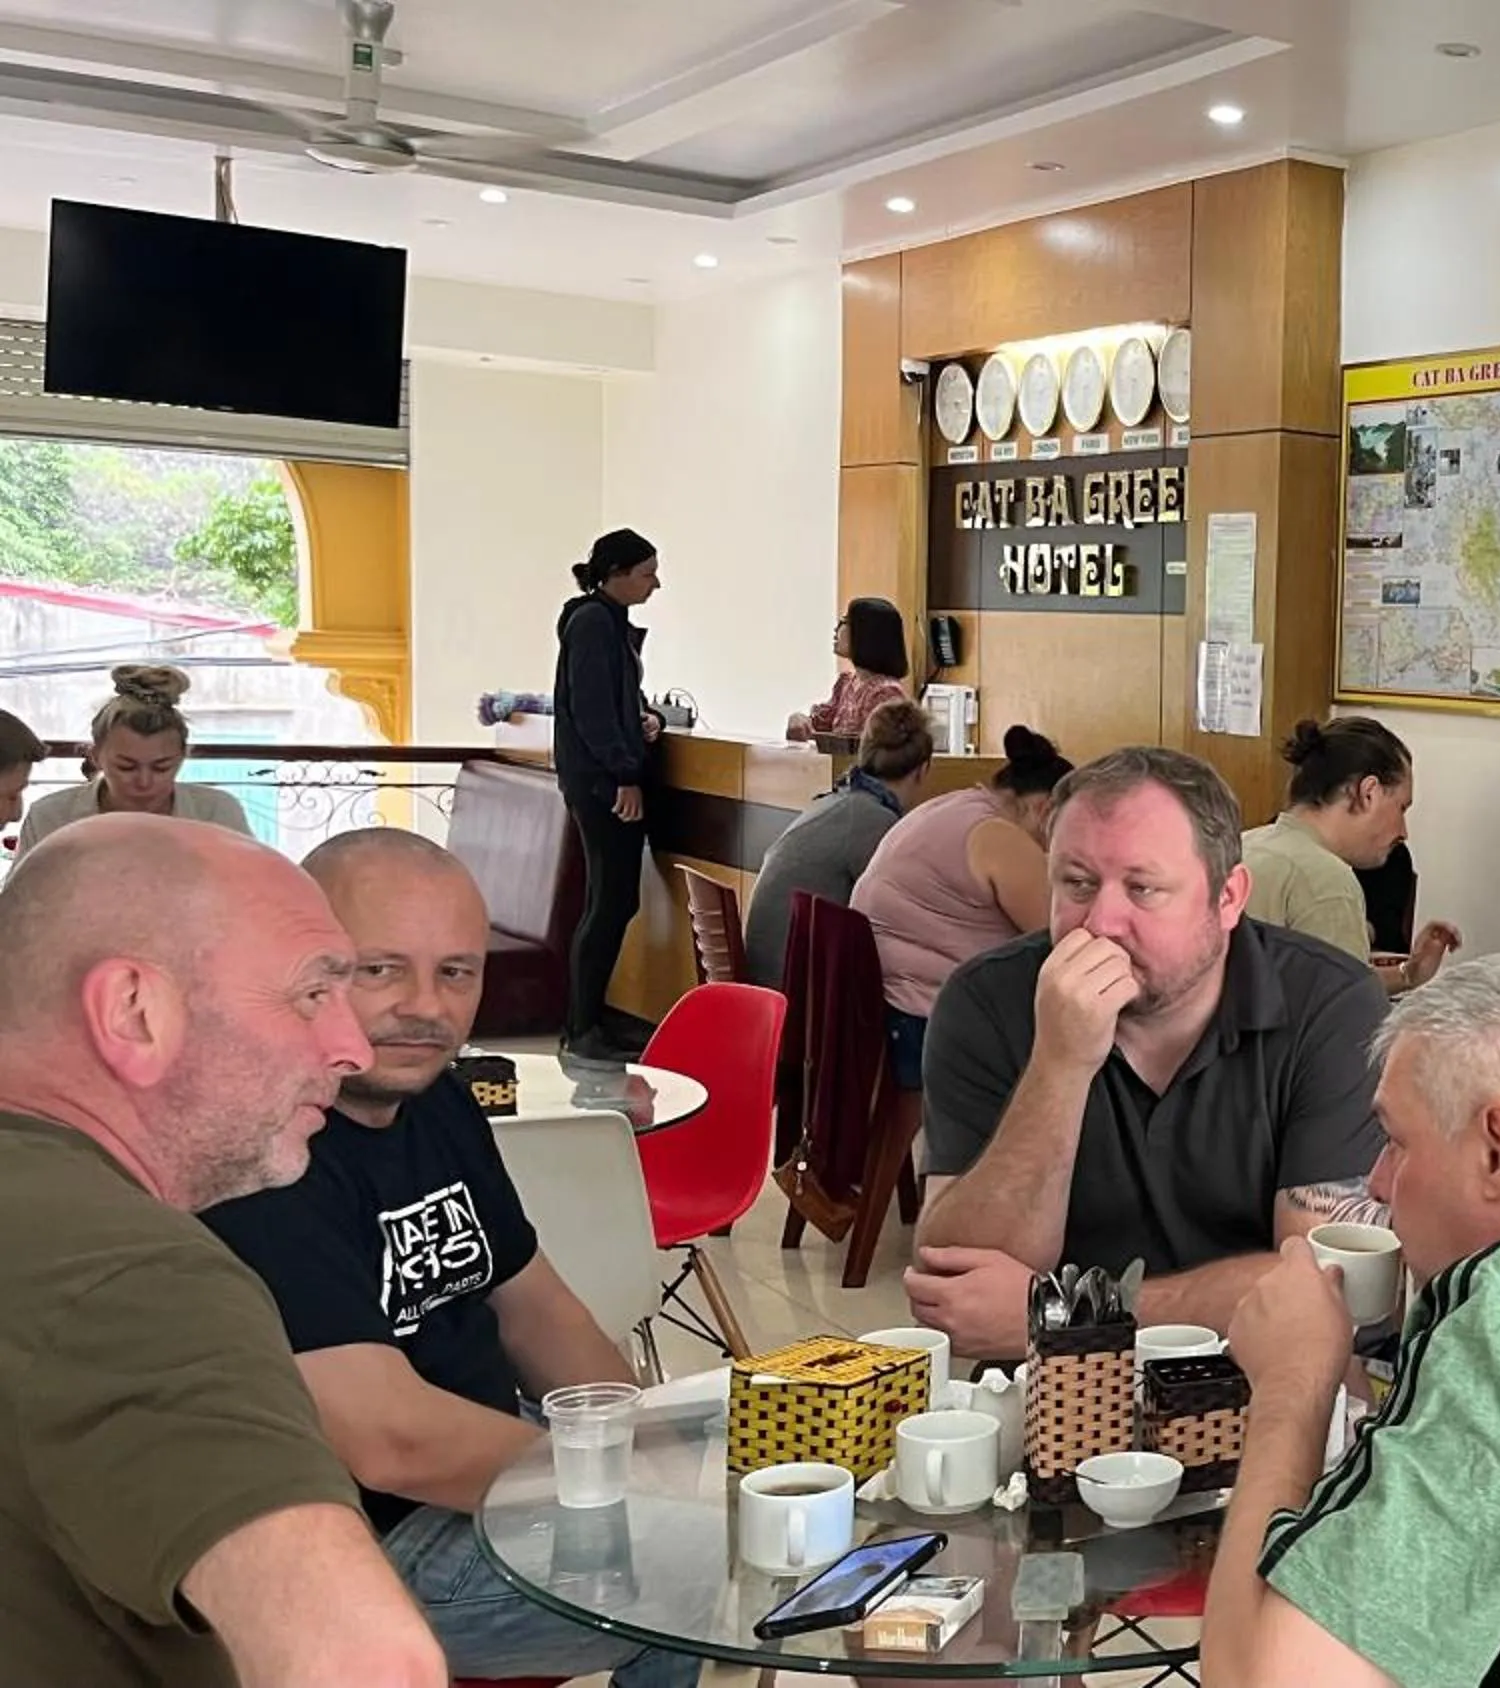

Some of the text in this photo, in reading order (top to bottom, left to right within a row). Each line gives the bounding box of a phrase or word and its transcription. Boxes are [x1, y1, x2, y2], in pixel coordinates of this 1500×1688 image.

[1413, 369, 1439, 387] CAT
[1445, 367, 1465, 384] BA
[956, 467, 1187, 529] CAT BA GREE
[1000, 543, 1124, 597] HOTEL
